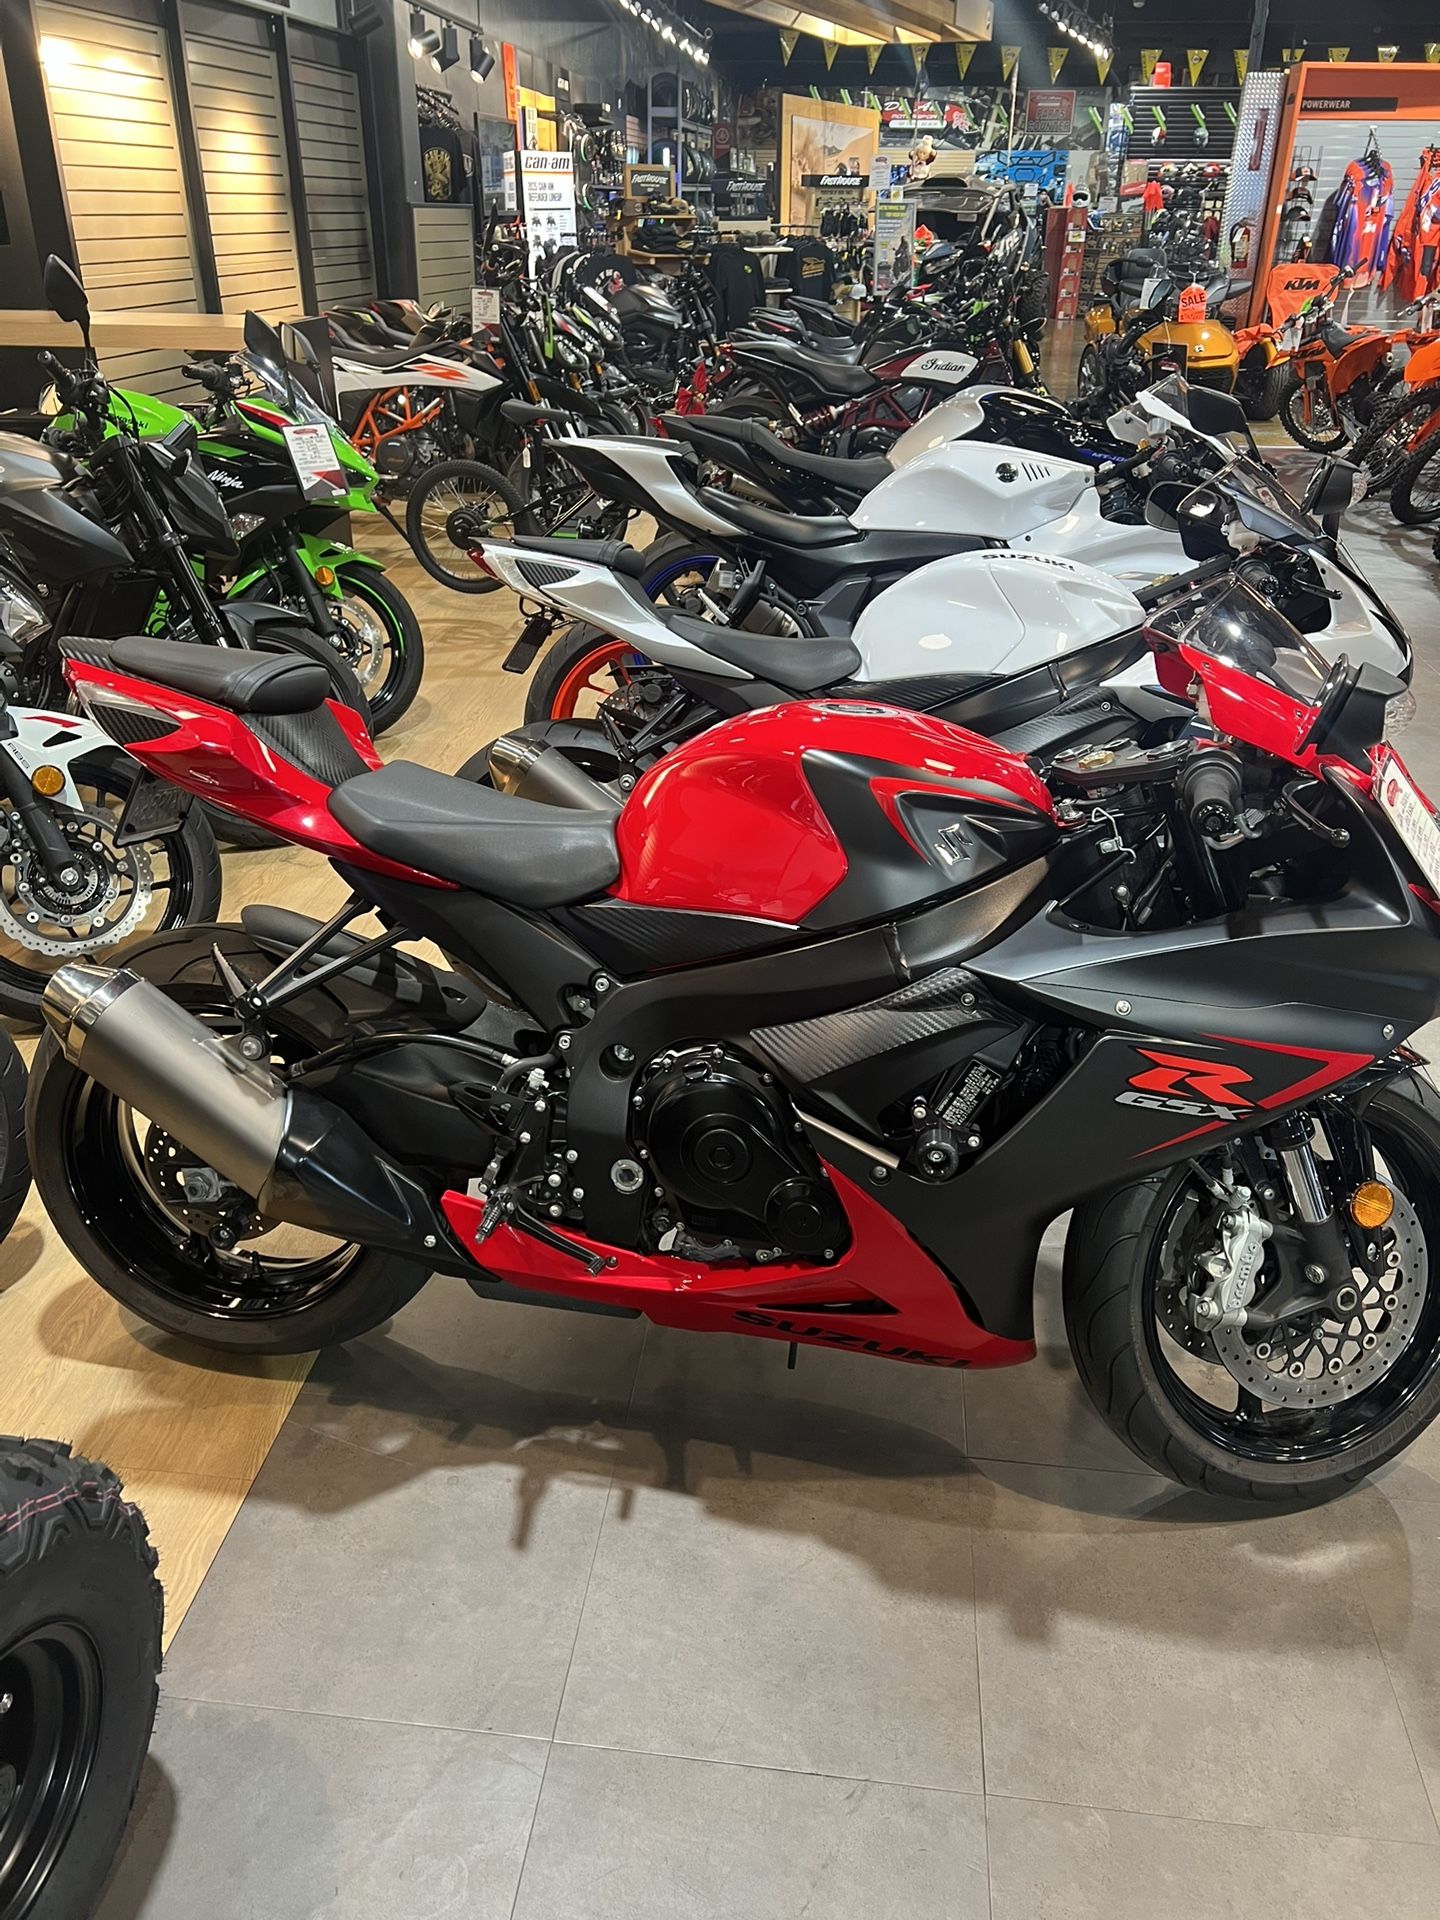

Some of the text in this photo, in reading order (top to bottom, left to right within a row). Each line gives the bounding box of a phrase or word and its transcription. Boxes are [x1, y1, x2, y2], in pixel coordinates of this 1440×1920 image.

[1302, 100, 1351, 110] POWERWEAR
[1284, 278, 1320, 291] KTM
[1181, 292, 1206, 308] SALE
[921, 358, 967, 374] Indian
[207, 469, 245, 489] Ninja
[982, 554, 1076, 572] SUZUKI
[1114, 1090, 1255, 1121] GSX
[732, 1310, 973, 1369] SUZUKI
